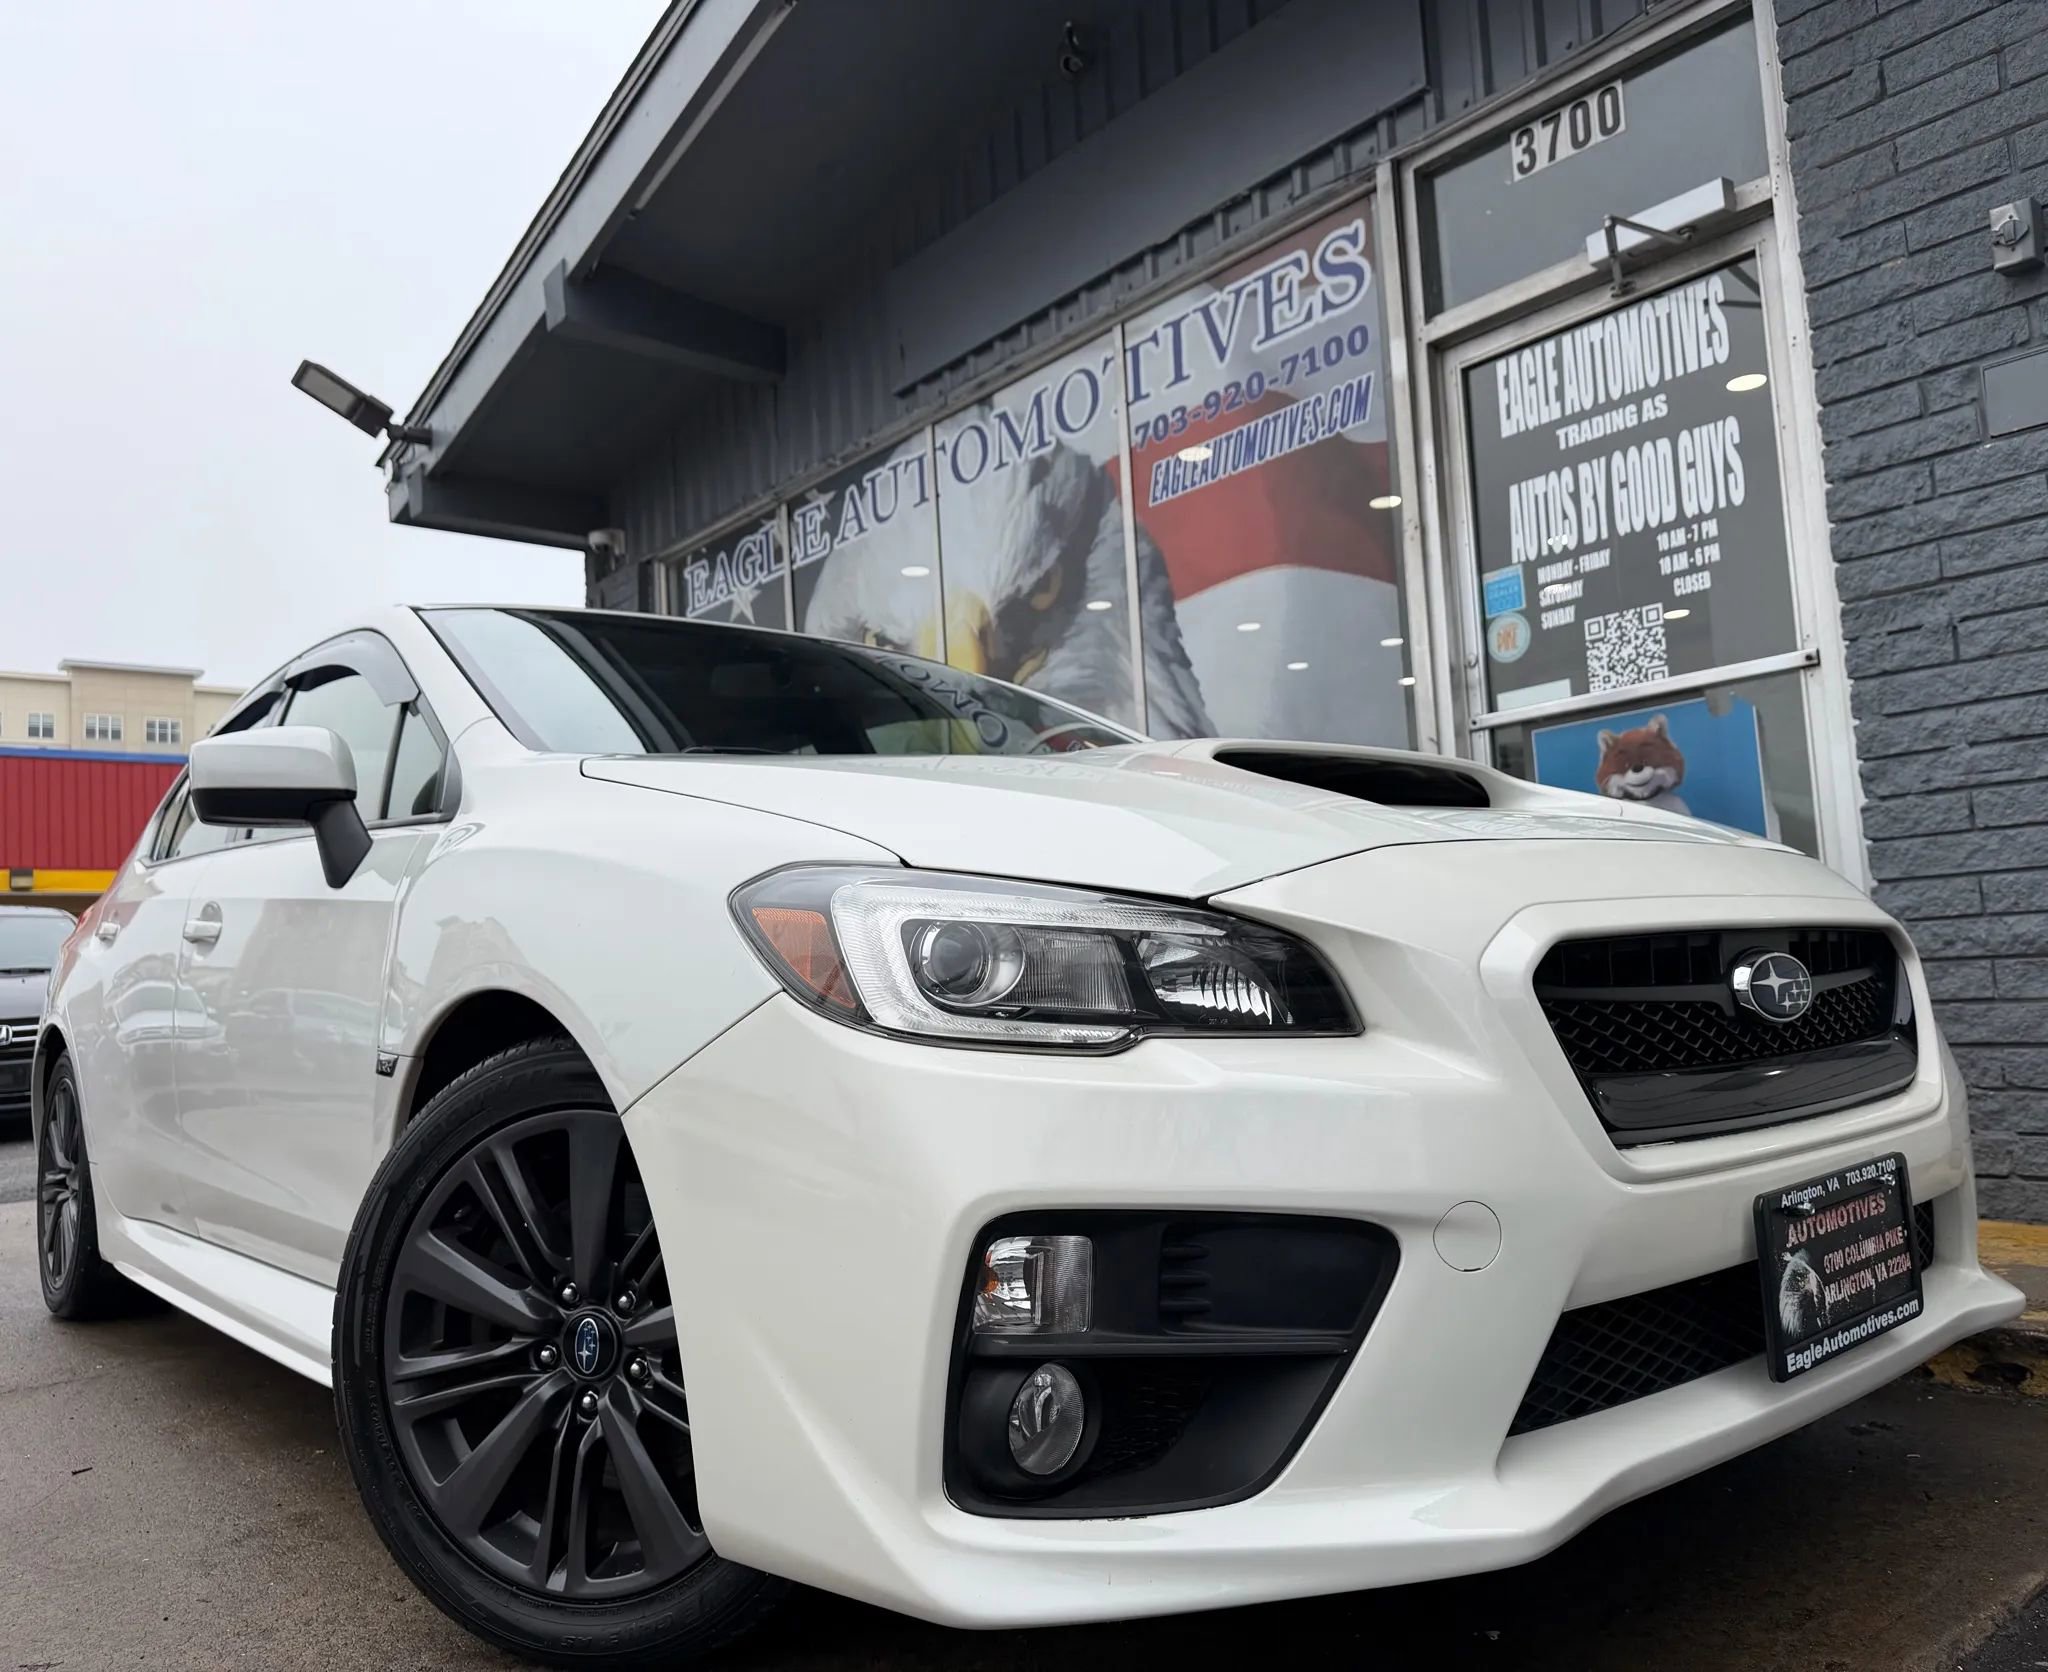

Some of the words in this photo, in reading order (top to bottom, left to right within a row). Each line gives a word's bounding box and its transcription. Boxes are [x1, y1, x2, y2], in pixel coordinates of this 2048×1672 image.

[1514, 86, 1620, 175] 3700
[1496, 339, 1562, 439] EAGLE
[1561, 275, 1730, 417] AUTOMOTIVES
[1135, 324, 1369, 450] 703-920-7100
[684, 500, 832, 618] EAGLE
[834, 218, 1371, 549] AUTOMOTIVES
[1149, 370, 1375, 507] EAGLEAUTOMOTIVES.COM
[1556, 403, 1638, 450] TRADING
[1642, 393, 1668, 422] AS
[1509, 466, 1579, 564] AUTOS
[1578, 455, 1609, 545] BY
[1610, 437, 1678, 537] GOOD
[1677, 415, 1745, 519] GUYS
[1656, 531, 1670, 552] 10
[1669, 526, 1686, 549] AM
[1701, 518, 1719, 541] PM
[1658, 555, 1672, 576] 10
[1672, 550, 1689, 573] AM
[1703, 542, 1721, 565] PM
[1537, 558, 1574, 585] MONDAY
[1579, 548, 1611, 574] FRIDAY
[1673, 570, 1712, 597] CLOSED
[1539, 579, 1584, 608] SATURDAY
[1541, 604, 1576, 630] SUNDAY
[1781, 1184, 1825, 1209] Arlington,
[1826, 1178, 1840, 1192] VA
[1845, 1158, 1896, 1187] 703.920.7100
[1787, 1192, 1887, 1248] AUTOMOTIVES
[1845, 1235, 1885, 1266] COLUMBIA
[1875, 1262, 1888, 1283] VA
[1786, 1298, 1919, 1374] EagleAutomotives.com
